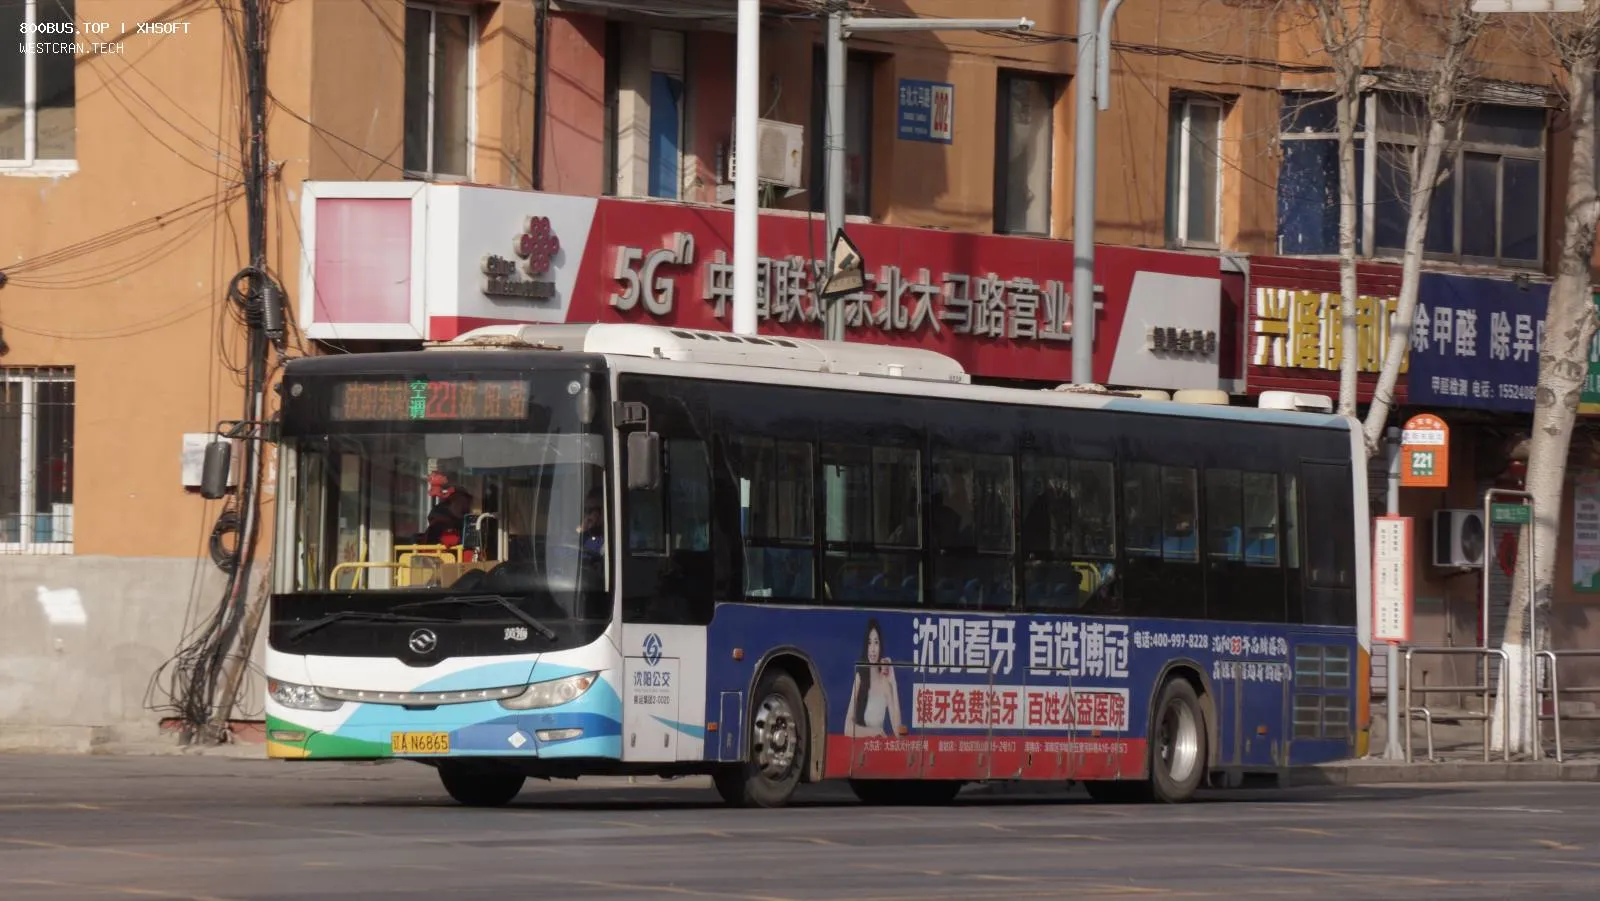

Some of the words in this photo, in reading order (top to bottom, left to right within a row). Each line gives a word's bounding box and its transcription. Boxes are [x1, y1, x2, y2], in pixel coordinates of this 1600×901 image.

[410, 380, 428, 419] 空调
[425, 381, 457, 418] 221
[1413, 452, 1432, 468] 221
[913, 617, 1016, 675] 沈阳看牙
[1029, 620, 1129, 678] 首选博冠
[633, 671, 671, 687] 沈阳公交
[916, 689, 1018, 725] 镶牙免费治牙
[1027, 692, 1126, 728] 百姓公益医院
[411, 735, 448, 750] N6865
